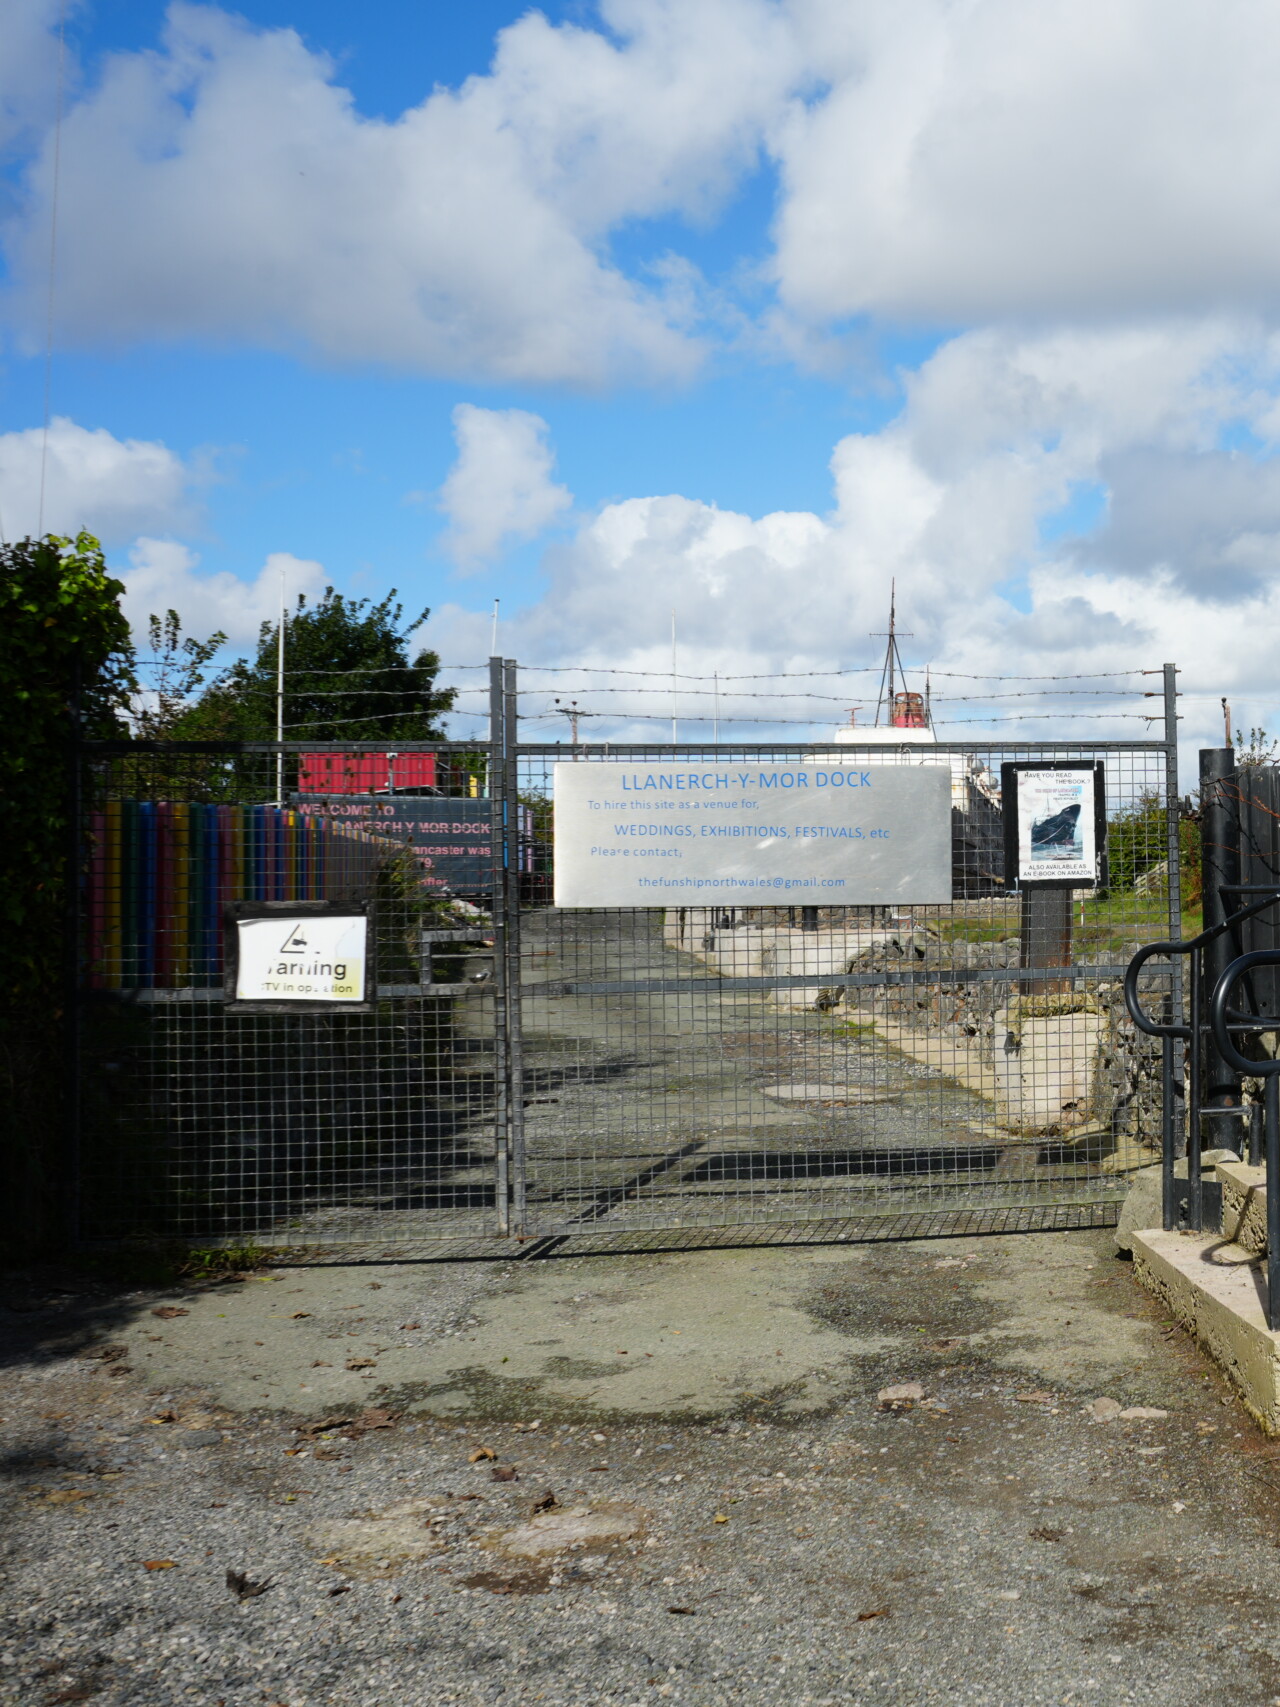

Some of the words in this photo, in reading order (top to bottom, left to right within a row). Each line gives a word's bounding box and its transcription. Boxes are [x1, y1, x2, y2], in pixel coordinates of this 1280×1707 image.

[816, 771, 872, 787] DOCK
[299, 803, 372, 816] WELCOME
[588, 800, 600, 810] To
[604, 800, 627, 809] hire
[630, 800, 651, 809] this
[655, 800, 675, 809] site
[693, 801, 700, 809] a
[704, 801, 738, 809] venue
[741, 799, 760, 810] for,
[418, 822, 449, 834] MOR
[451, 822, 491, 834] DOCK
[614, 824, 696, 838] WEDDINGS,
[701, 825, 791, 839] EXHIBITIONS,
[795, 826, 866, 840] FESTIVALS,
[870, 828, 890, 838] etc
[412, 845, 465, 855] ancaster
[467, 846, 492, 855] was
[638, 877, 846, 888] thefunshipnorthwales@gmail.com
[267, 960, 347, 980] arning
[283, 983, 294, 992] in
